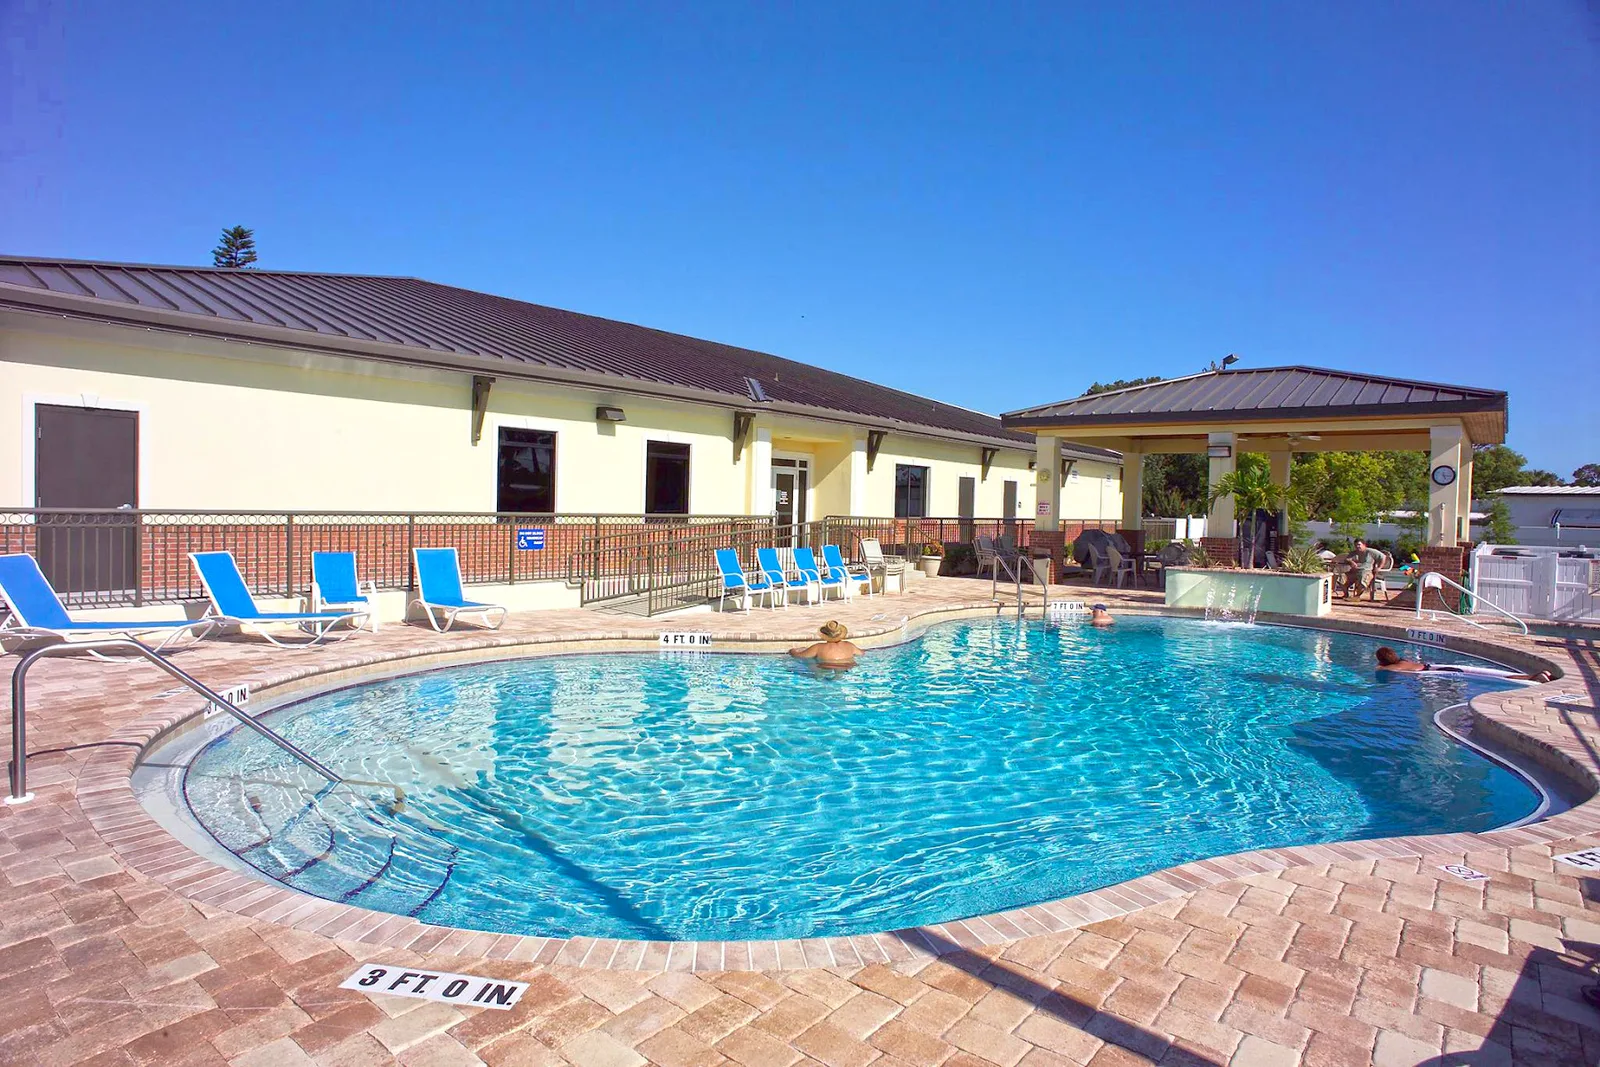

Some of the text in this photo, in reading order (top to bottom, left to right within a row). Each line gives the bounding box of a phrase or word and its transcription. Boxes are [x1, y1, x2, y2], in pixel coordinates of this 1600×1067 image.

[663, 634, 669, 644] 4
[689, 634, 695, 644] 0
[1410, 630, 1415, 638] 7
[1564, 856, 1594, 867] 4
[358, 968, 518, 1006] 3 FT. 0 IN.
